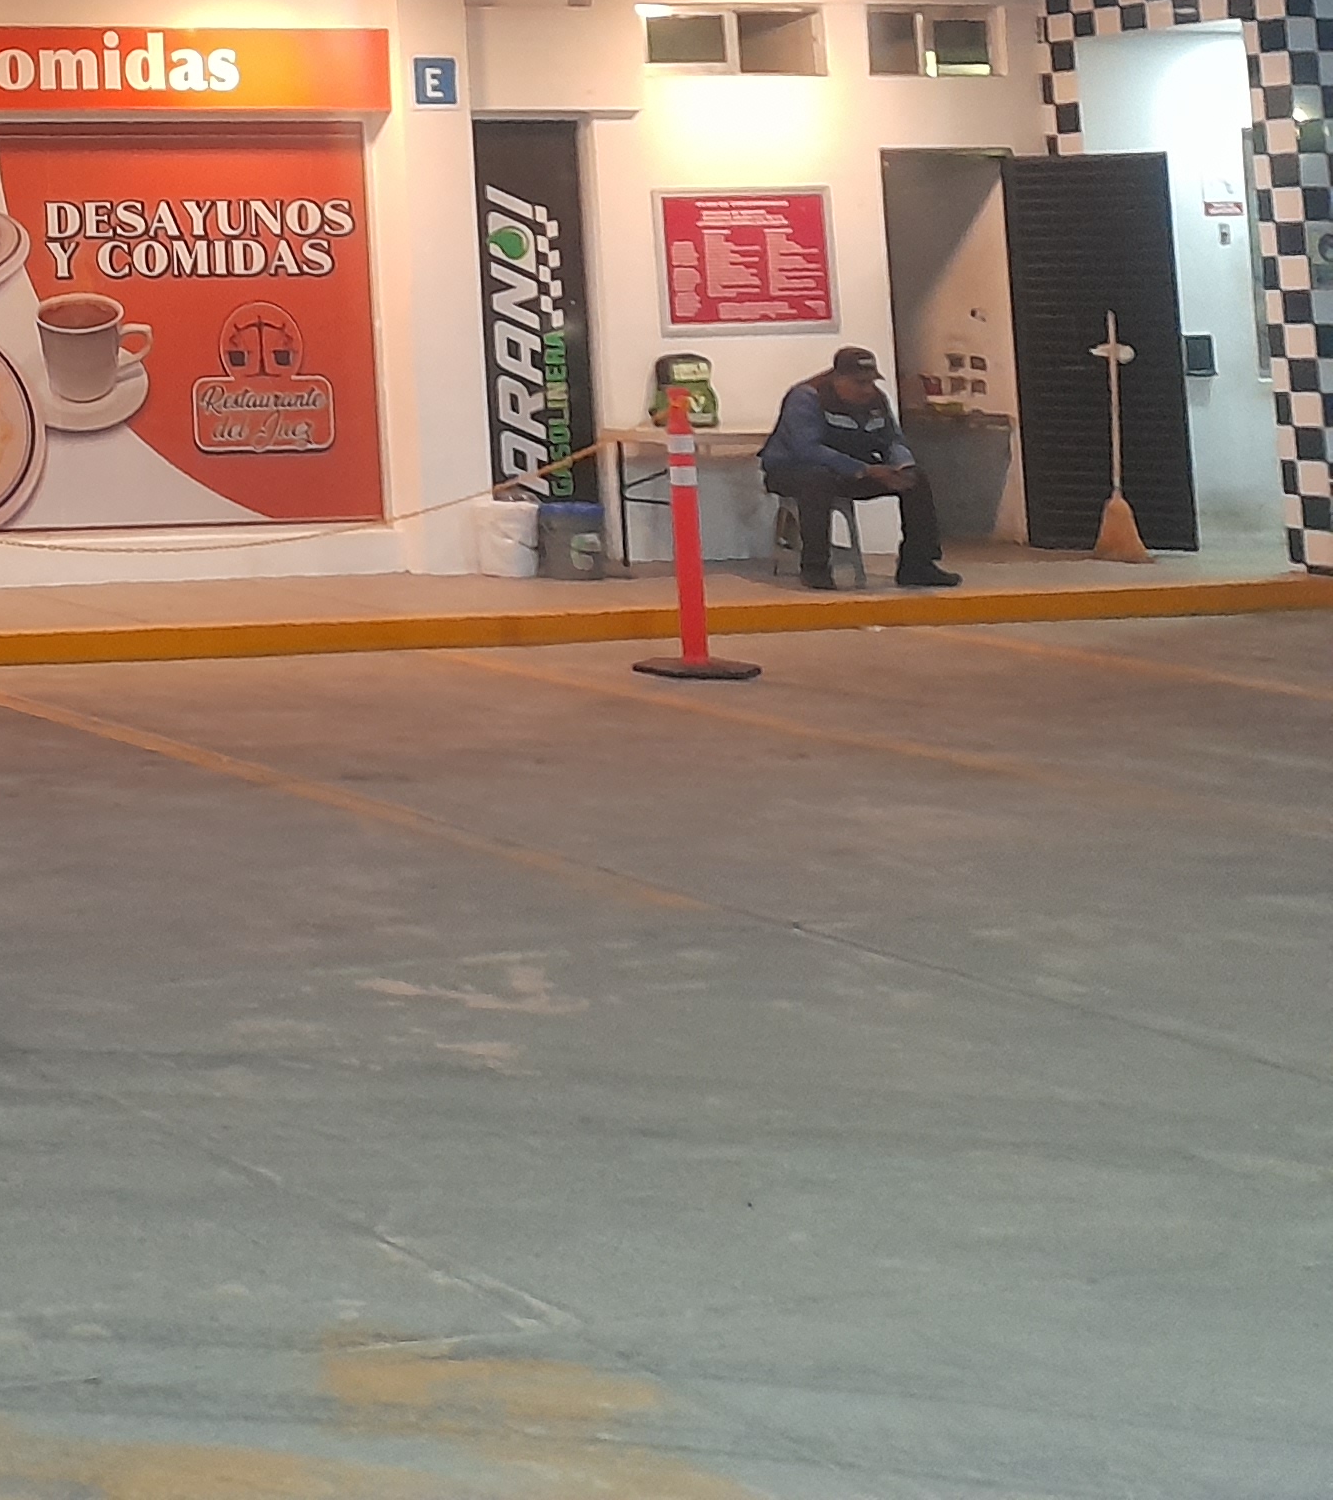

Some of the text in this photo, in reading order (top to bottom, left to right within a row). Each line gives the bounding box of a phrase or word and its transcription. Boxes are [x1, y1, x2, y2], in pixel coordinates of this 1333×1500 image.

[424, 66, 444, 98] E
[45, 200, 354, 238] DESAYUNOS
[46, 239, 335, 279] Y COMIDAS
[200, 383, 326, 416] Restaurante
